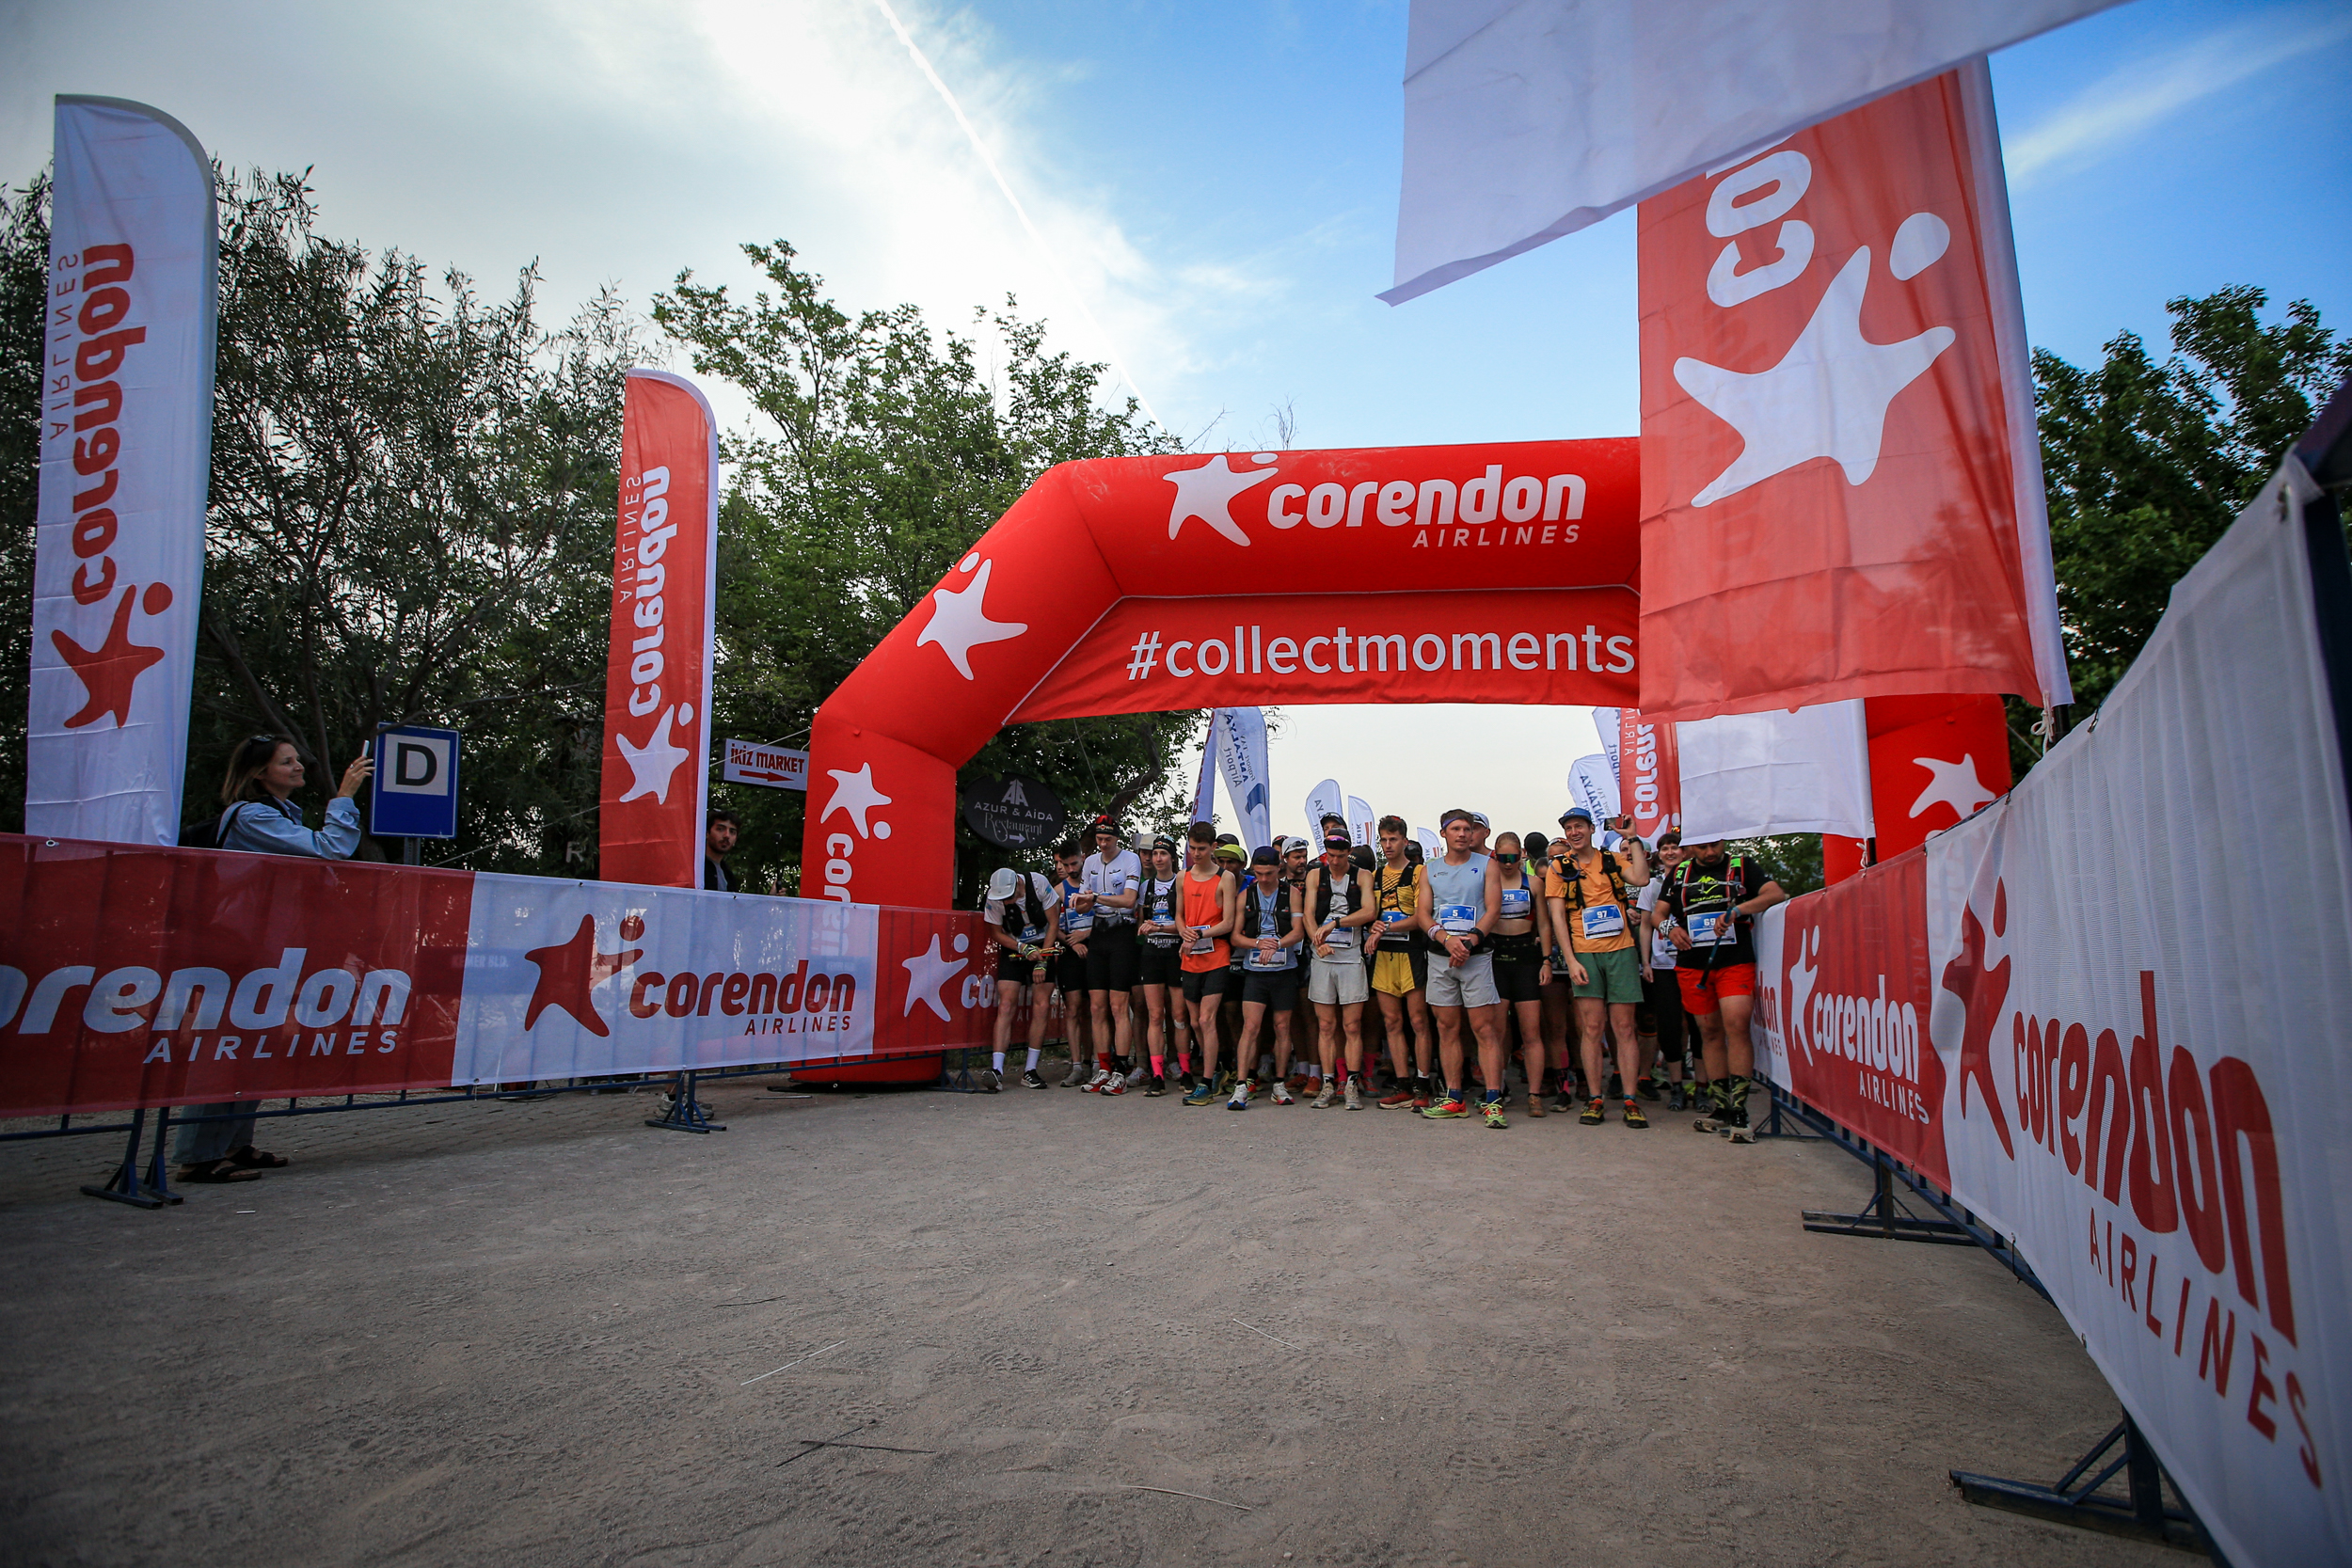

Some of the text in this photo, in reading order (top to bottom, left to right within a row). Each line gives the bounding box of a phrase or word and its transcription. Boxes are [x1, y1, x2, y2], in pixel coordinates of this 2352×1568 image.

[1266, 464, 1587, 529] corendon
[1412, 524, 1581, 548] AIRLINES
[1125, 625, 1636, 681] #collectmoments
[395, 742, 437, 786] D
[755, 752, 805, 773] MARKET
[974, 801, 1008, 815] AZUR
[1011, 808, 1021, 816] &
[984, 812, 1043, 844] Restaurant
[1452, 909, 1458, 917] 5
[1597, 910, 1608, 919] 97
[1025, 928, 1037, 937] 123
[628, 959, 857, 1019] corendon
[744, 1016, 851, 1037] AIRLINES
[1813, 974, 1919, 1085] corendon
[143, 1030, 398, 1064] AIRLINES
[1858, 1072, 1931, 1125] AIRLINES
[2012, 970, 2298, 1350] corendon
[2090, 1206, 2322, 1490] AIRLINES
